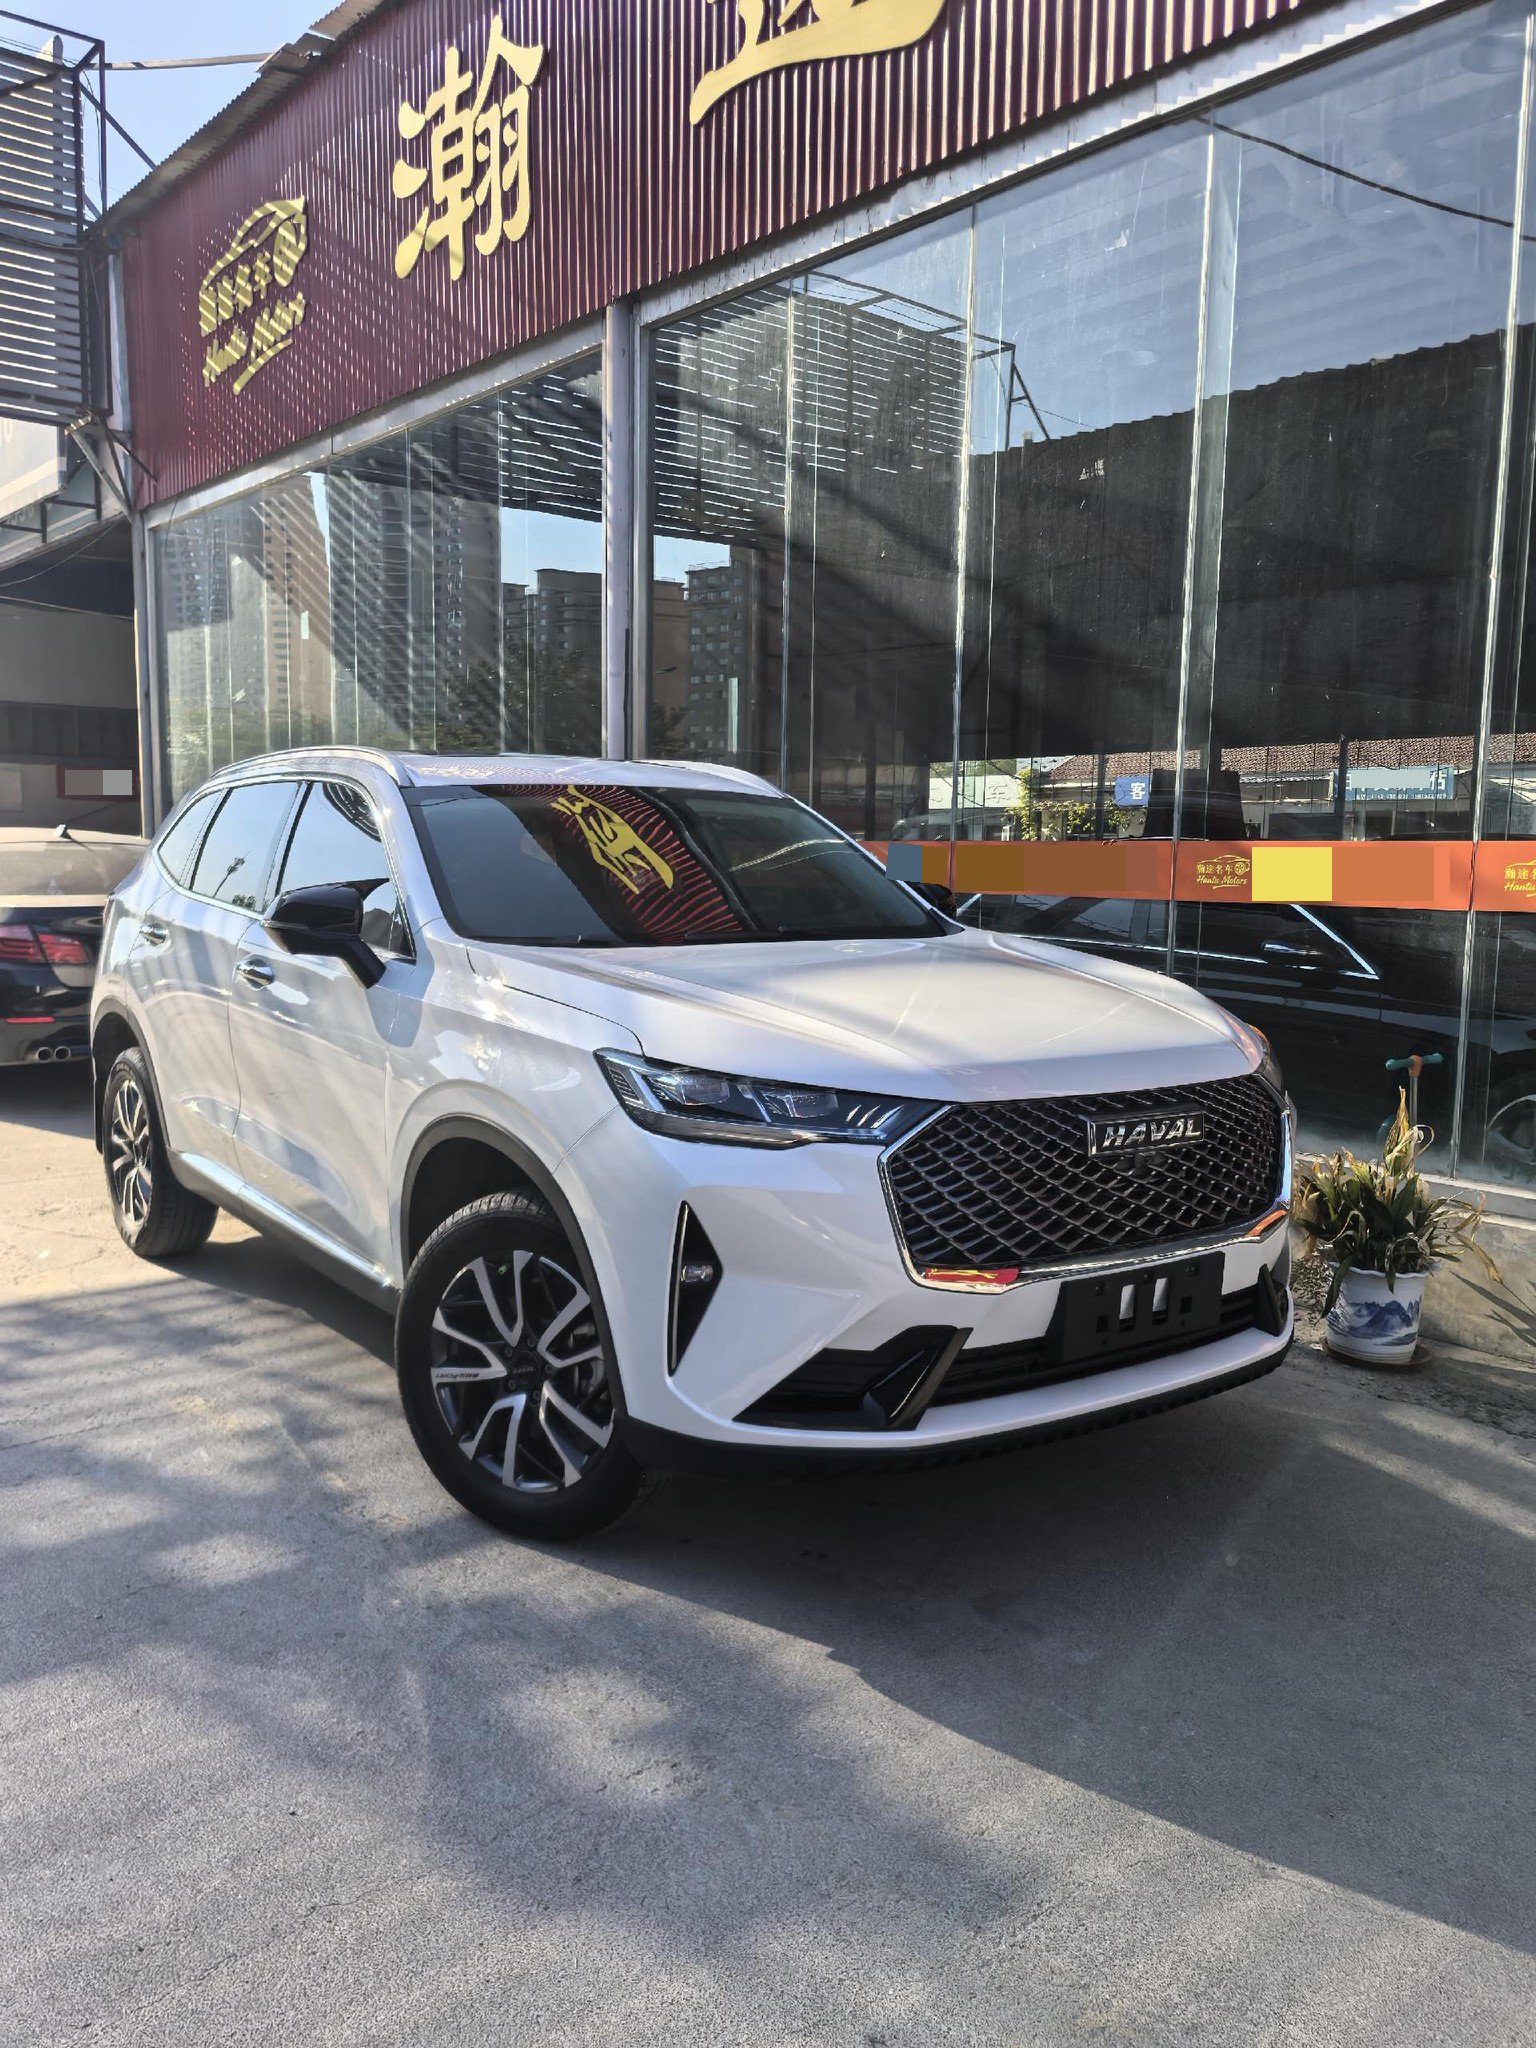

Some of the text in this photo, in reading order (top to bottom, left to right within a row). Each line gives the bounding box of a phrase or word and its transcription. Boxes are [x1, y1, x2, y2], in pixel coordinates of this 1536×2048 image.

[1130, 782, 1146, 800] 客
[1221, 875, 1248, 885] Motors
[1101, 1117, 1201, 1148] HAVAL
